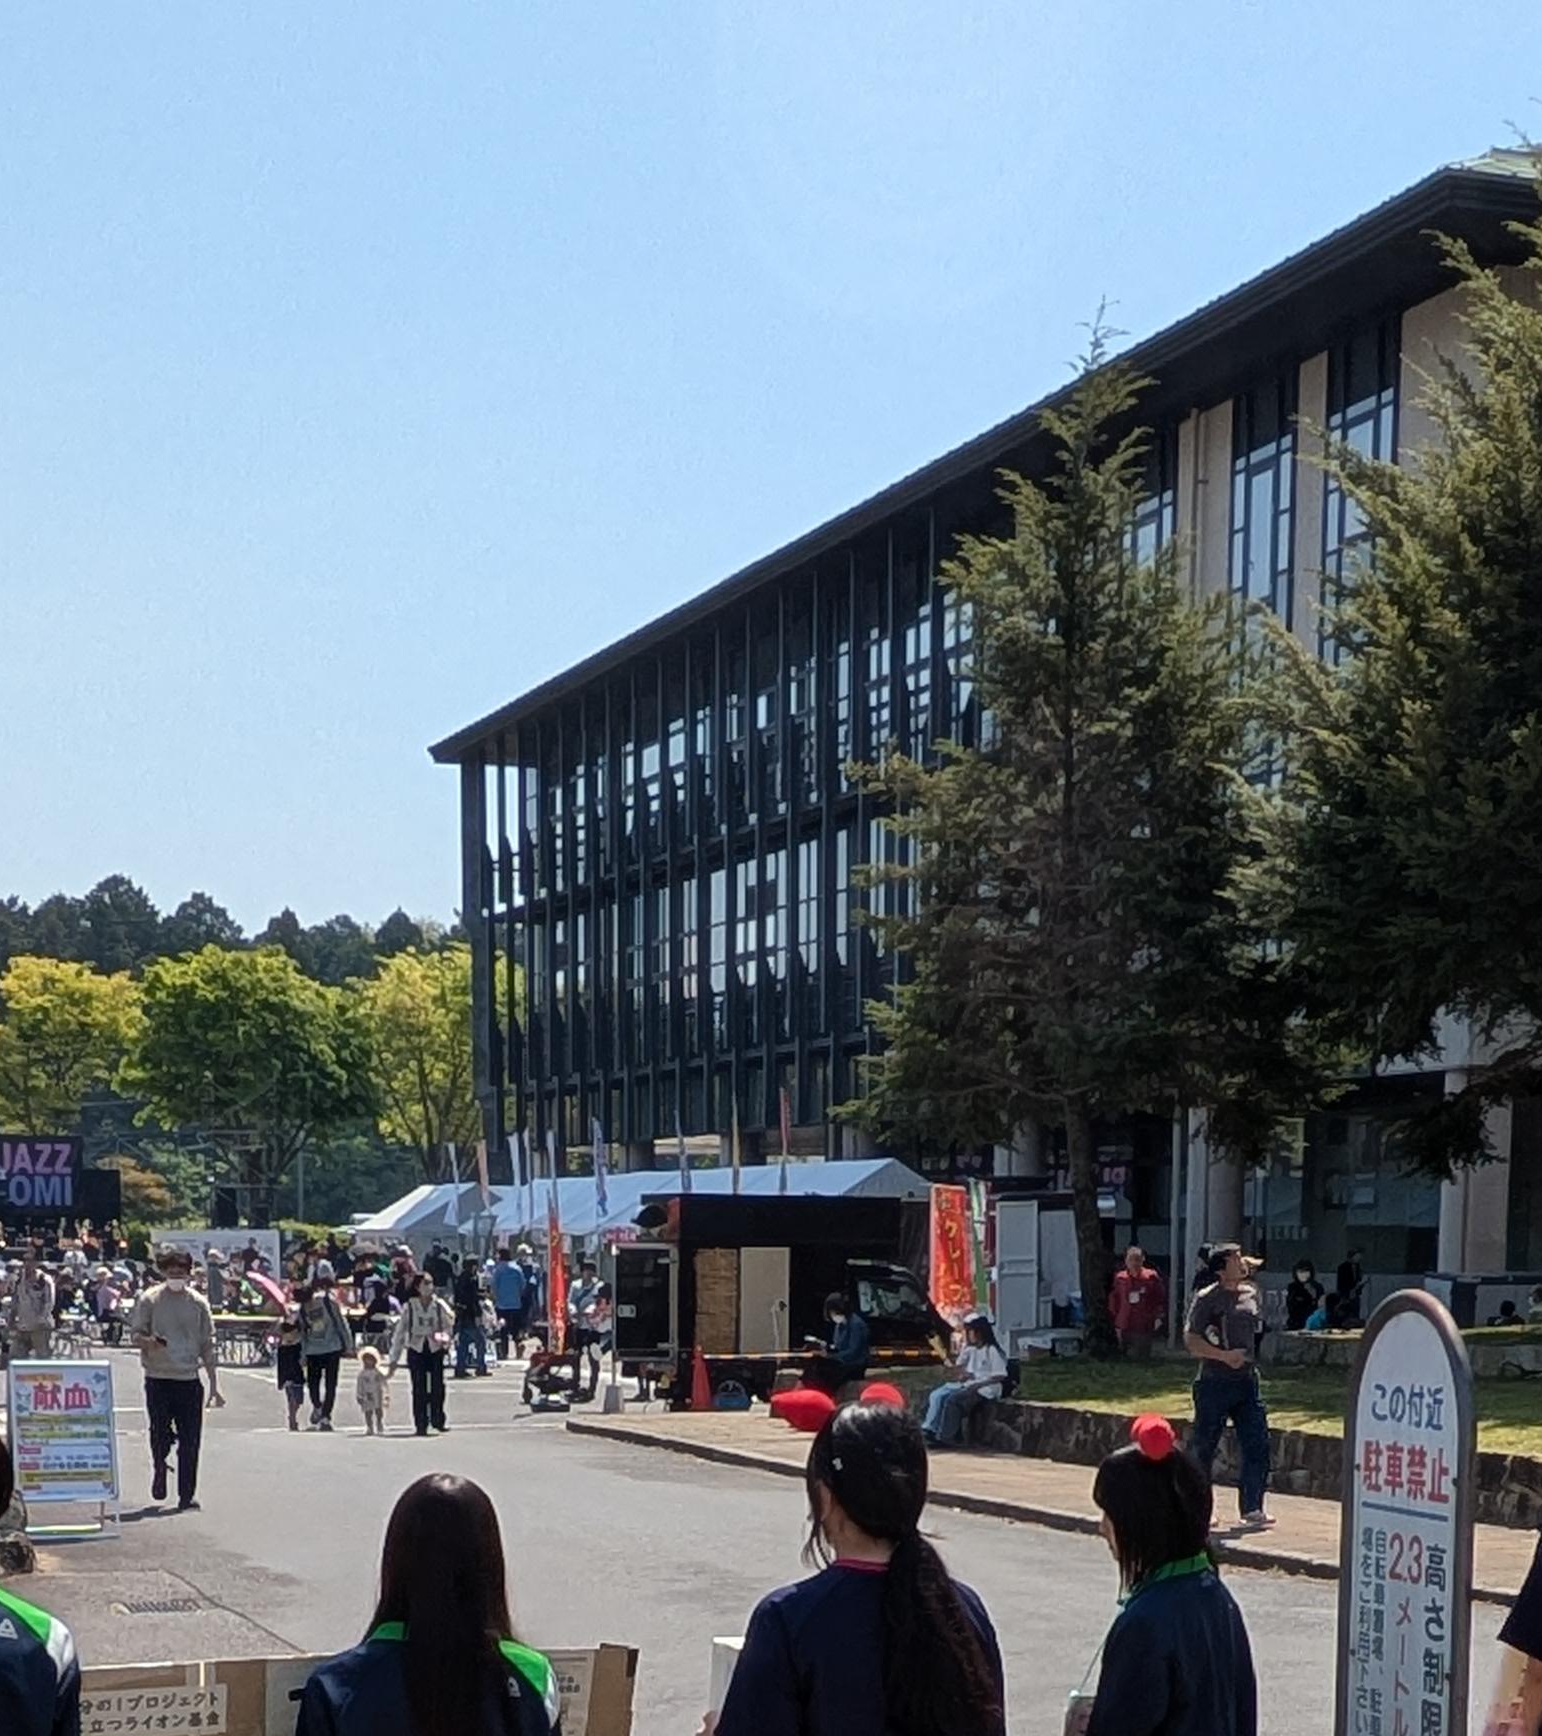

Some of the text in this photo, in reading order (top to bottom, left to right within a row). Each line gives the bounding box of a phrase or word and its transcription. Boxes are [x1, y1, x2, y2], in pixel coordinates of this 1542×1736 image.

[33, 1382, 93, 1411] 献血
[1371, 1383, 1444, 1431] この付近
[1362, 1439, 1450, 1504] 駐車禁止
[79, 1710, 220, 1735] 立つライオン基金
